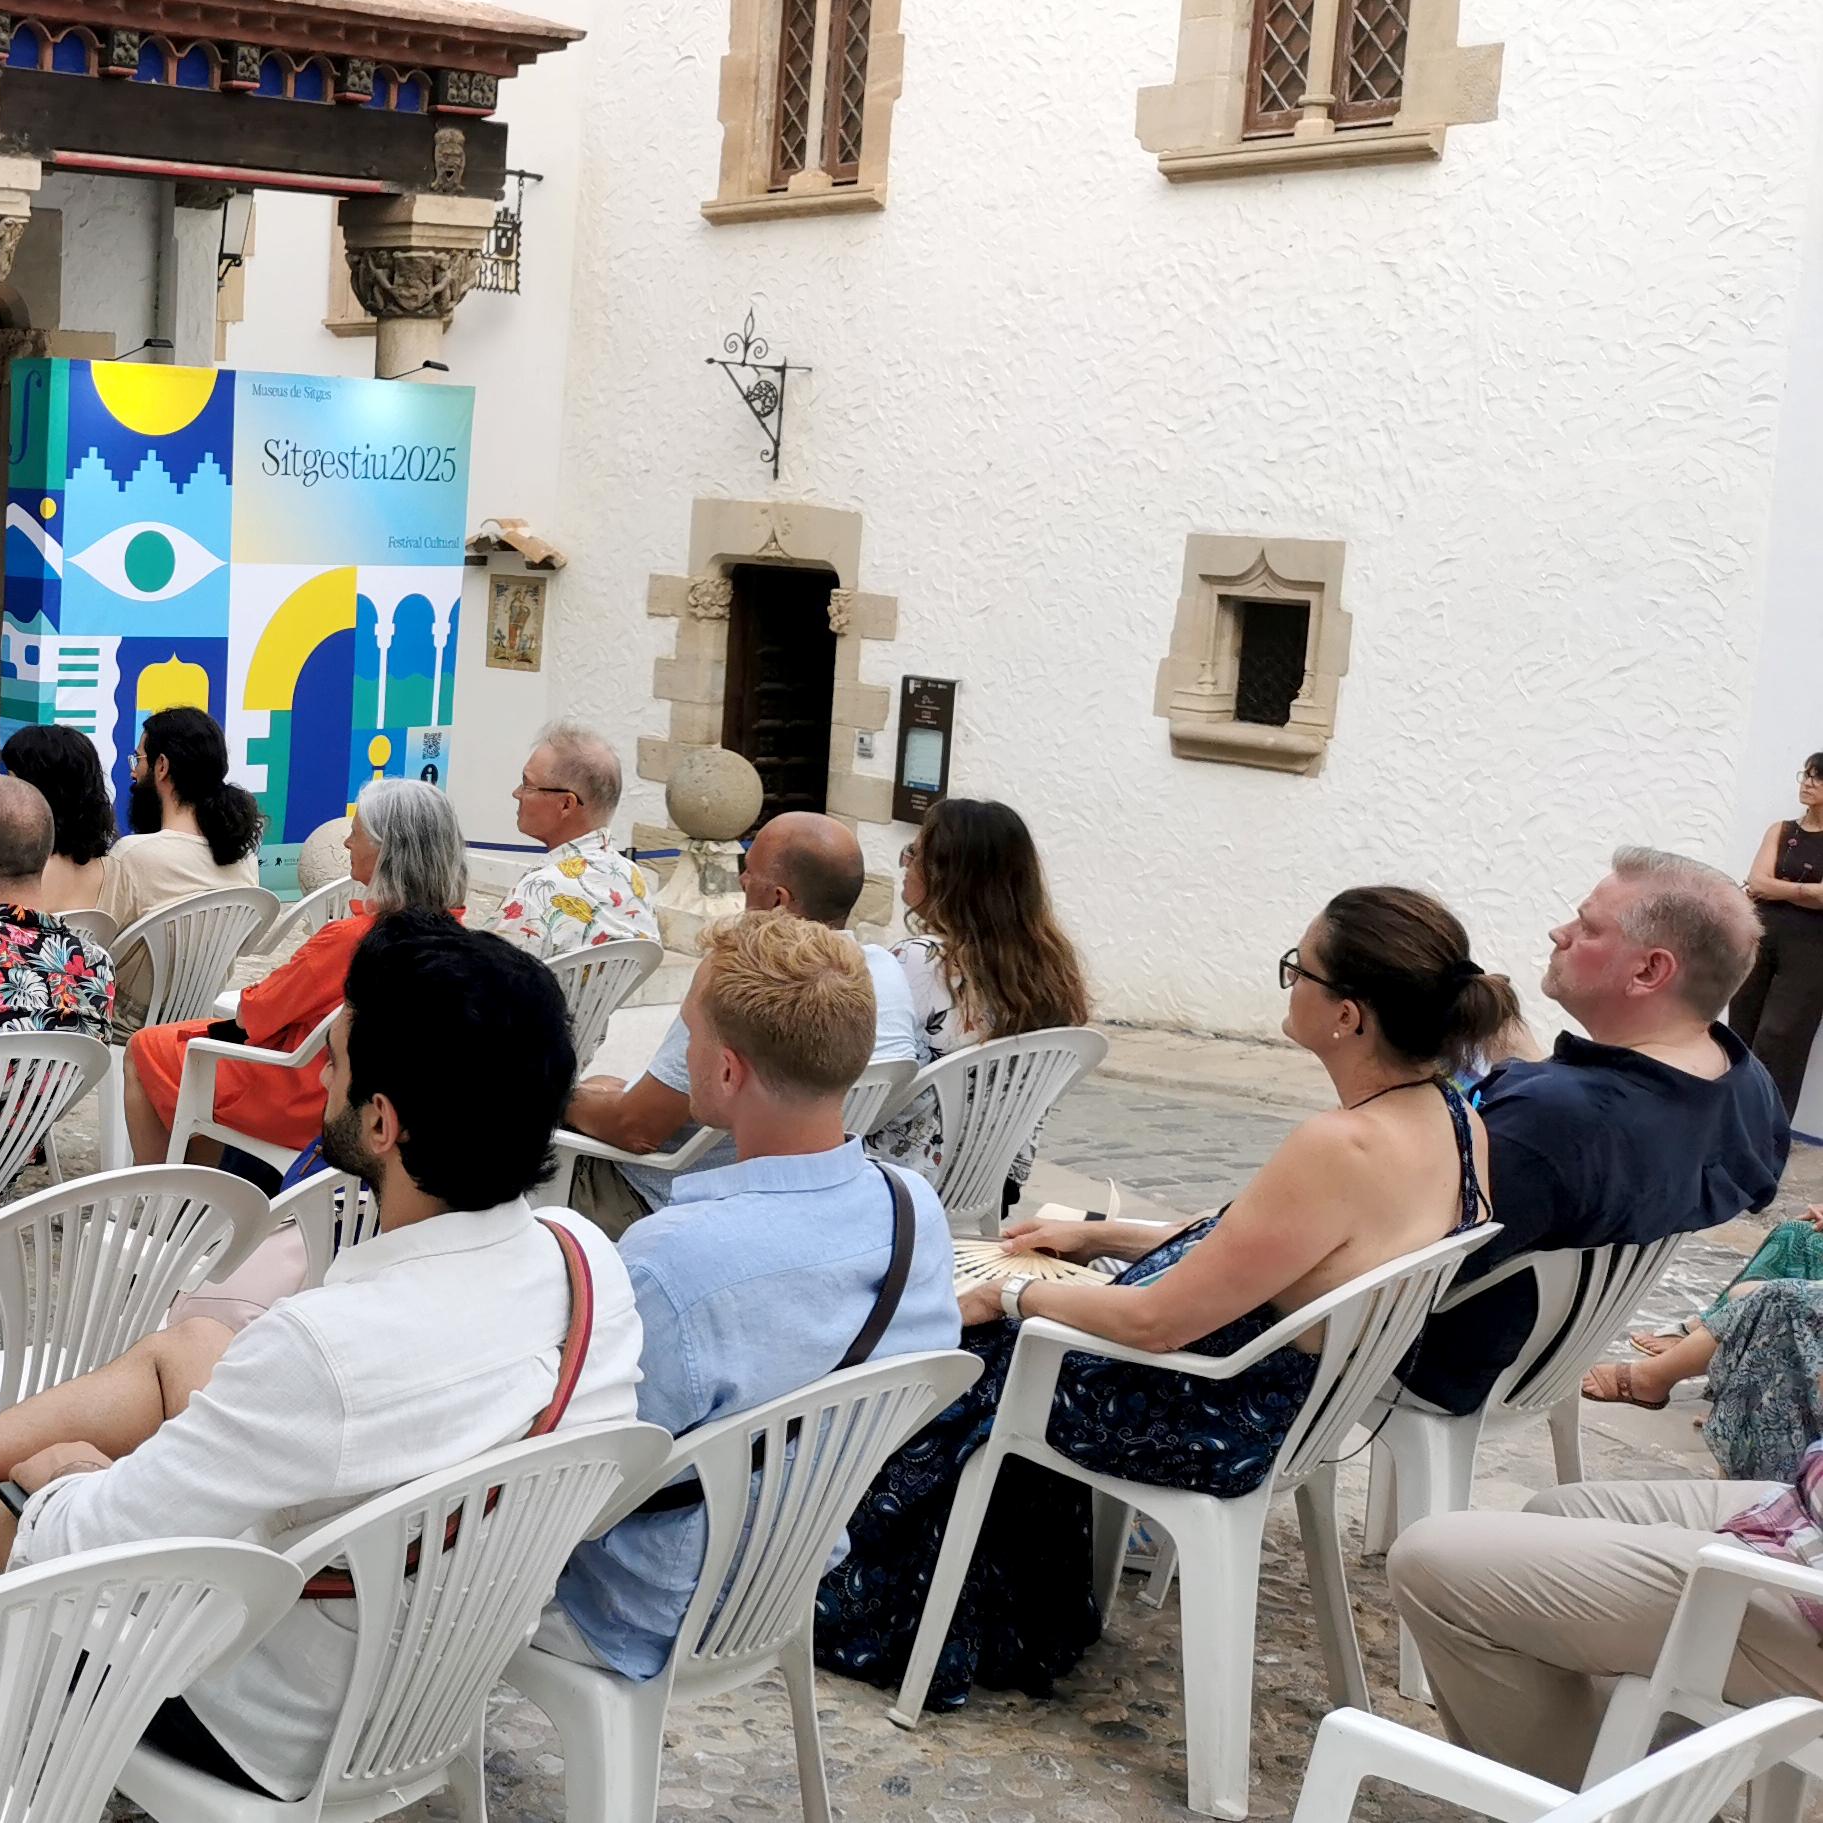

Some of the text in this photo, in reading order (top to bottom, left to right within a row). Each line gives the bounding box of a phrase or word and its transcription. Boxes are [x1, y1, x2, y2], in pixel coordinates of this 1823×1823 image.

[252, 383, 332, 402] Museus de Sitges
[261, 438, 457, 487] Sitgestiu2025
[388, 536, 460, 549] Festival Cultural
